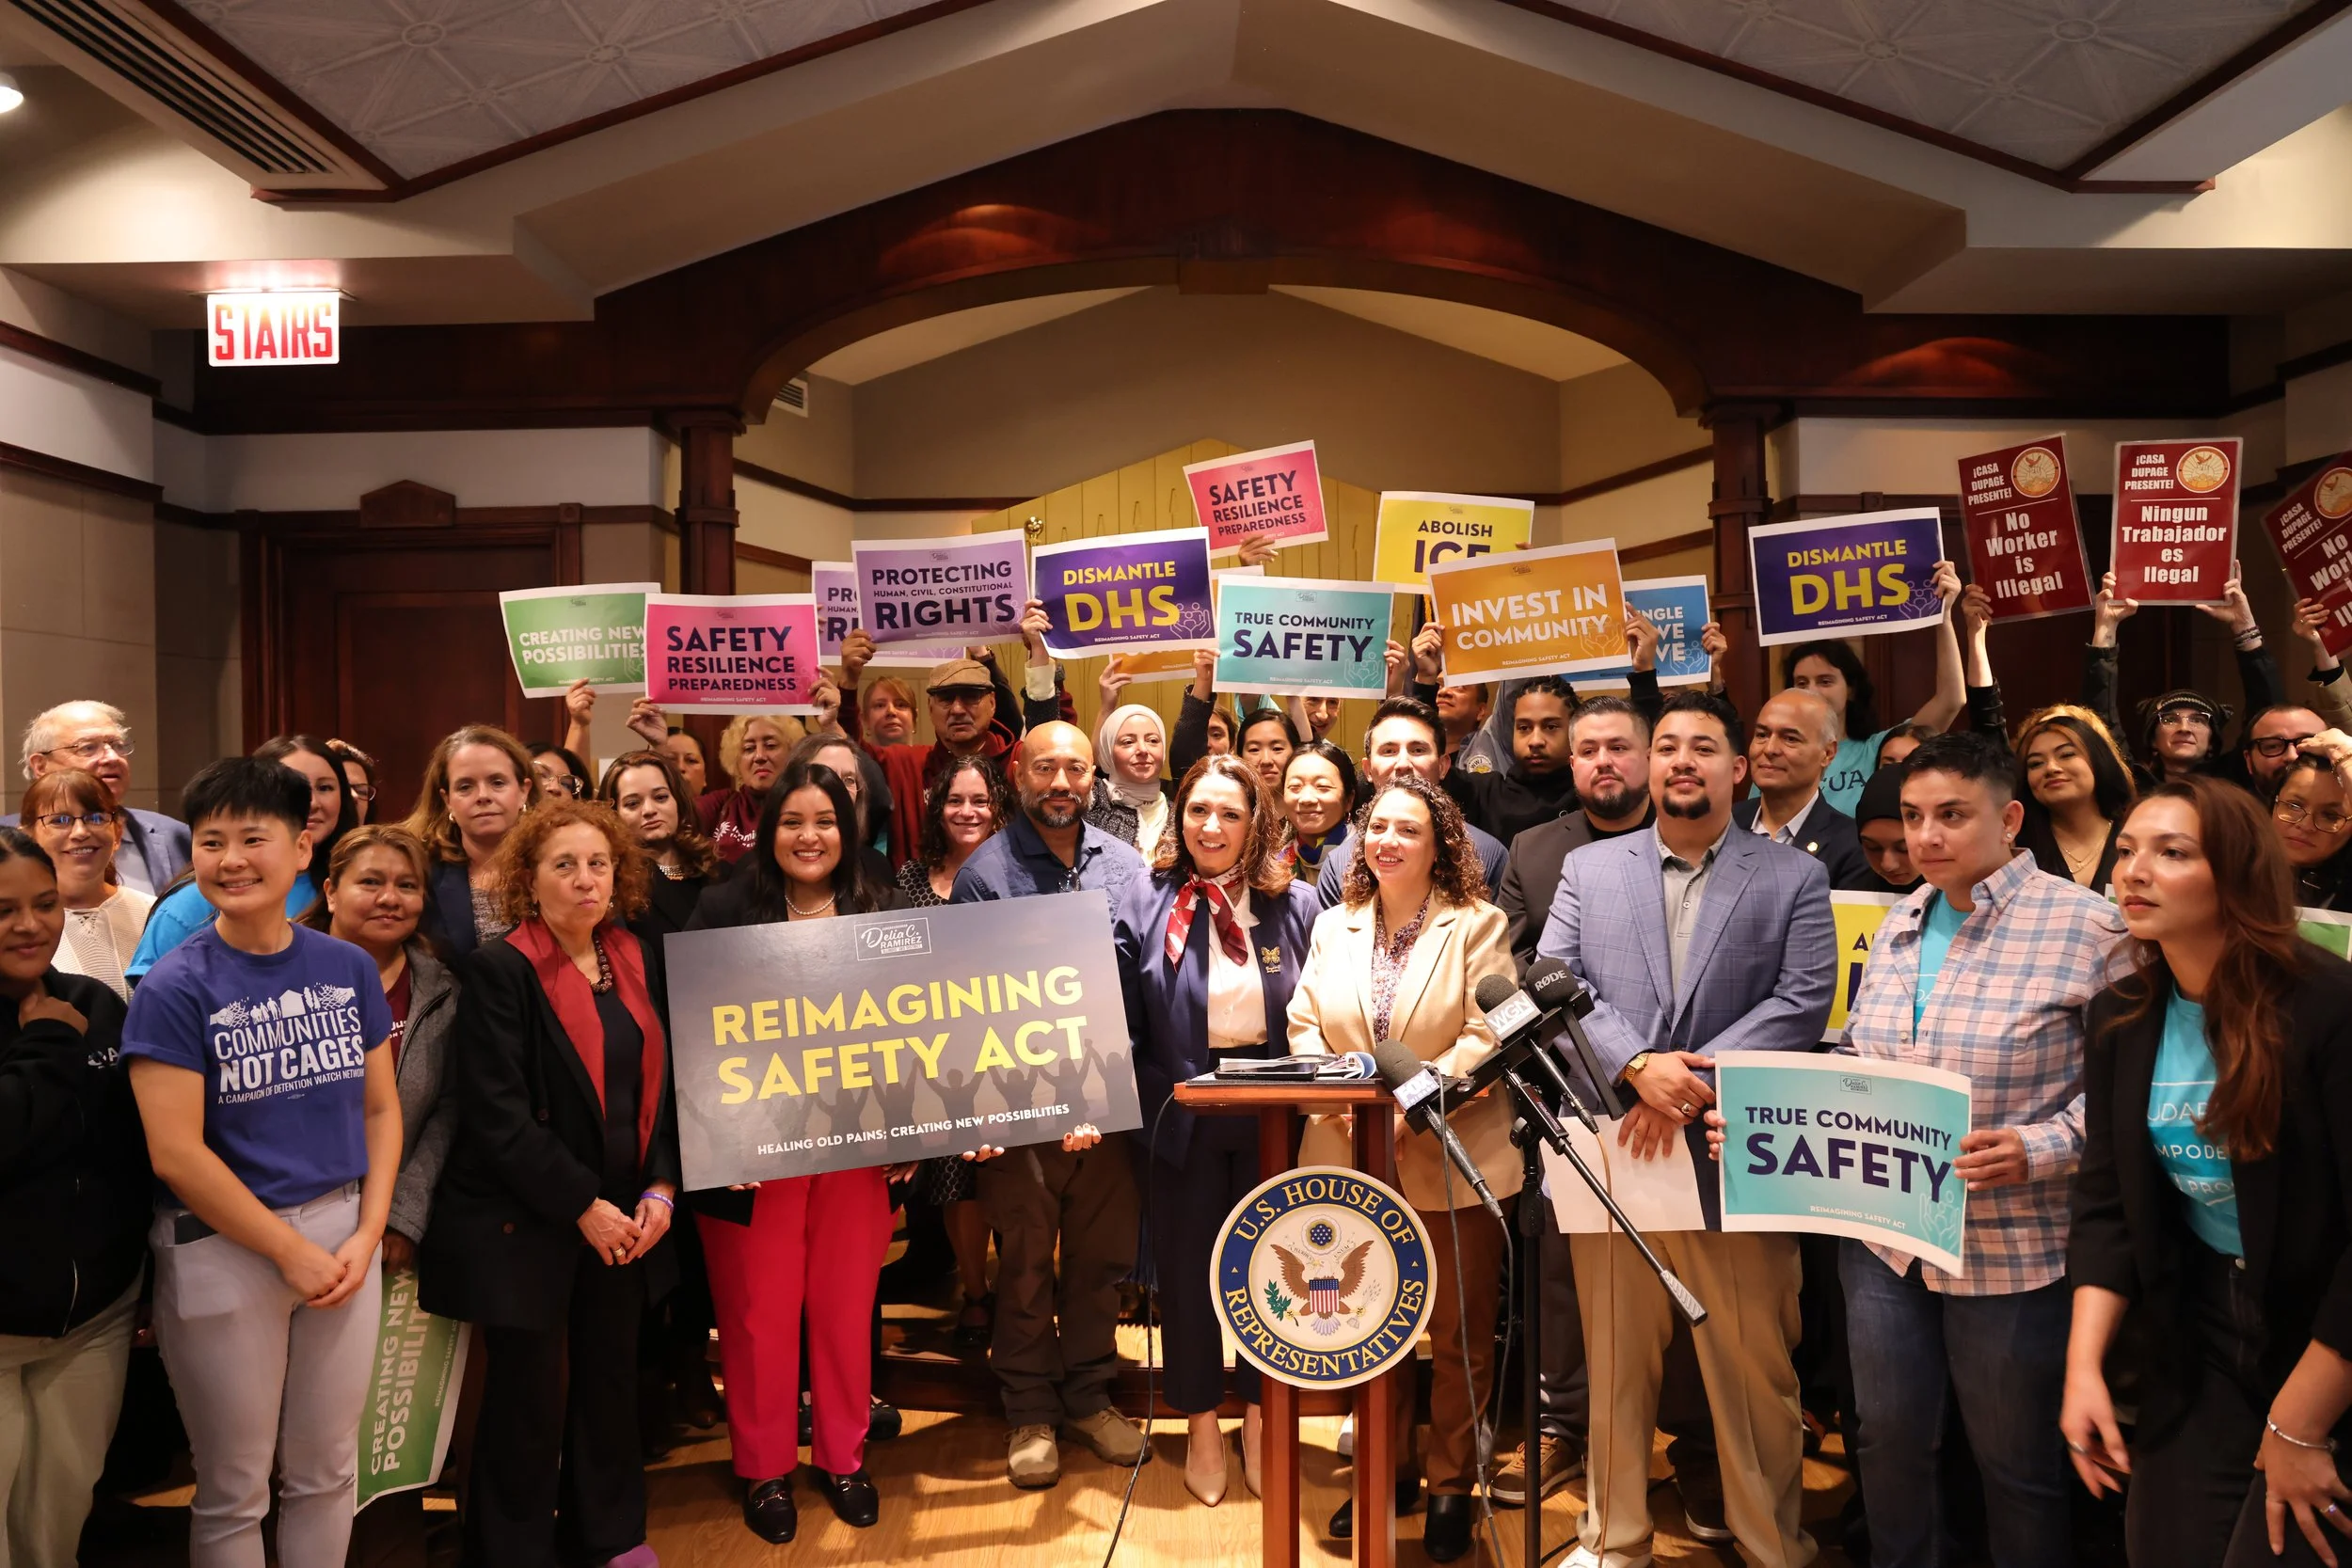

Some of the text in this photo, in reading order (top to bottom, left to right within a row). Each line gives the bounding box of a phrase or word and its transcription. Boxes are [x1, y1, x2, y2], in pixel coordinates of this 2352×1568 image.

[215, 301, 332, 360] STAIRS
[1972, 462, 1999, 479] ¡CASA
[2131, 466, 2169, 478] DUPAGE
[2136, 453, 2165, 466] ¡CASA
[1209, 469, 1296, 506] SAFETY
[1971, 475, 2005, 491] DUPAGE
[2124, 479, 2174, 491] PRESENTE!
[1213, 494, 1304, 523] RESILIENCE
[1967, 487, 2012, 506] PRESENTE!
[1217, 512, 1307, 536] PREPAREDNESS
[2005, 512, 2031, 532] No
[2140, 505, 2208, 524] Ningun
[2281, 511, 2313, 539] DUPAGE
[1417, 519, 1493, 538] ABOLISH
[2122, 525, 2227, 545] Trabajador
[2281, 518, 2324, 554] PRESENTE!
[1788, 539, 1907, 568] DISMANTLE
[1985, 530, 2058, 557] Worker
[2160, 546, 2184, 562] es
[2321, 533, 2349, 559] No
[872, 561, 1011, 585] PROTECTING
[1063, 561, 1176, 586] DISMANTLE
[2015, 555, 2035, 575] is
[2143, 565, 2199, 585] Ilegal
[911, 587, 936, 596] CIVIL,
[939, 581, 1013, 595] CONSTITUTIONAL
[1789, 563, 1911, 615] DHS
[1994, 571, 2064, 599] Illegal
[875, 594, 1016, 629] RIGHTS
[1064, 585, 1180, 632] DHS
[1451, 583, 1608, 627] INVEST IN
[1234, 611, 1375, 630] TRUE COMMUNITY
[1456, 613, 1609, 651] COMMUNITY
[518, 627, 602, 646] CREATING
[666, 626, 792, 652] SAFETY
[1232, 629, 1374, 662] SAFETY
[667, 657, 796, 673] RESILIENCE
[1502, 657, 1537, 666] REIMAGINING
[668, 677, 797, 691] PREPAREDNESS
[861, 924, 919, 948] Delia C.
[881, 936, 922, 949] RAMIREZ
[1534, 970, 1567, 992] RØDE
[711, 965, 1084, 1046] REIMAGINING
[1487, 995, 1535, 1030] WGN
[214, 1006, 361, 1060] COMMUNITIES
[219, 1035, 365, 1093] NOT CAGES
[718, 1015, 1088, 1105] SAFETY ACT
[217, 1096, 224, 1105] A
[225, 1089, 265, 1104] CAMPAIGN
[265, 1087, 273, 1098] OF
[274, 1077, 313, 1094] DETENTION
[313, 1071, 342, 1085] WATCH
[757, 1103, 1070, 1156] HEALING OLD PAINS; CREATING NEW POSSIBILITIES
[1745, 1106, 1952, 1150] TRUE COMMUNITY
[1746, 1132, 1952, 1203] SAFETY
[1234, 1178, 1416, 1245] U.S. HOUSE OF
[1810, 1205, 1906, 1229] REIMAGINING SAFETY ACT
[1225, 1279, 1424, 1376] REPRESENTATIVES
[371, 1267, 414, 1476] CREATING NEW
[383, 1298, 432, 1473] POSSIBILIT
